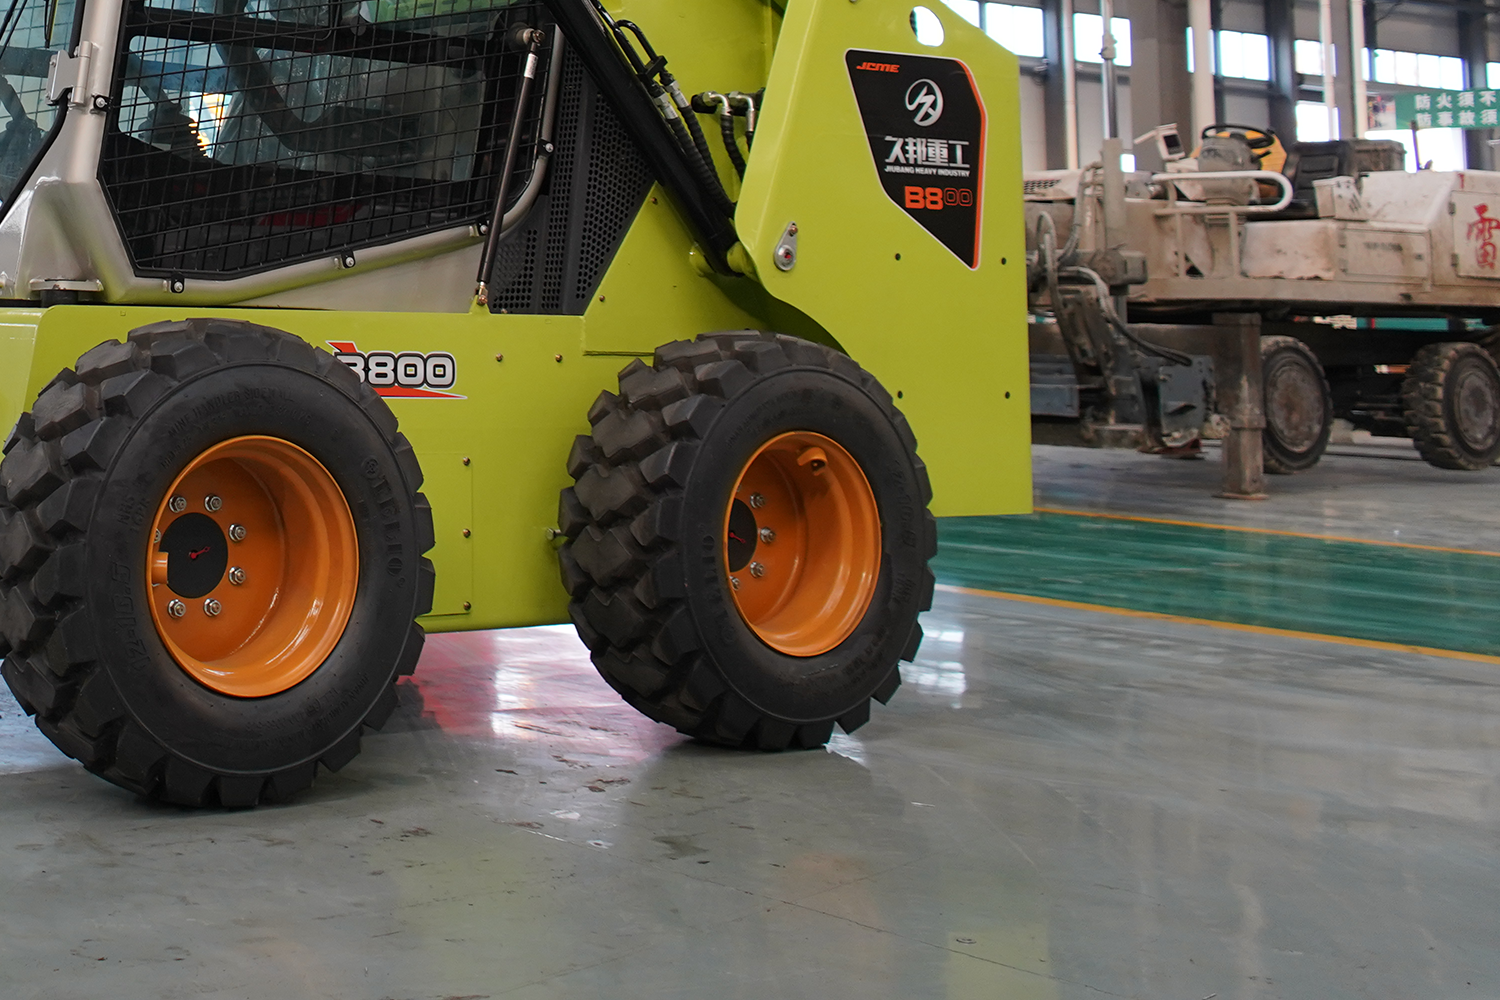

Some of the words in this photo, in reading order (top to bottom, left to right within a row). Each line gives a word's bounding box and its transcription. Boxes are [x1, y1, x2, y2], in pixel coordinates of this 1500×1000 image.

[856, 62, 900, 73] JCME
[884, 136, 970, 168] 久邦重工
[884, 165, 915, 174] JIUBANG
[915, 167, 937, 175] HEAVY
[937, 169, 970, 177] INDUSTRY
[904, 186, 973, 211] B800
